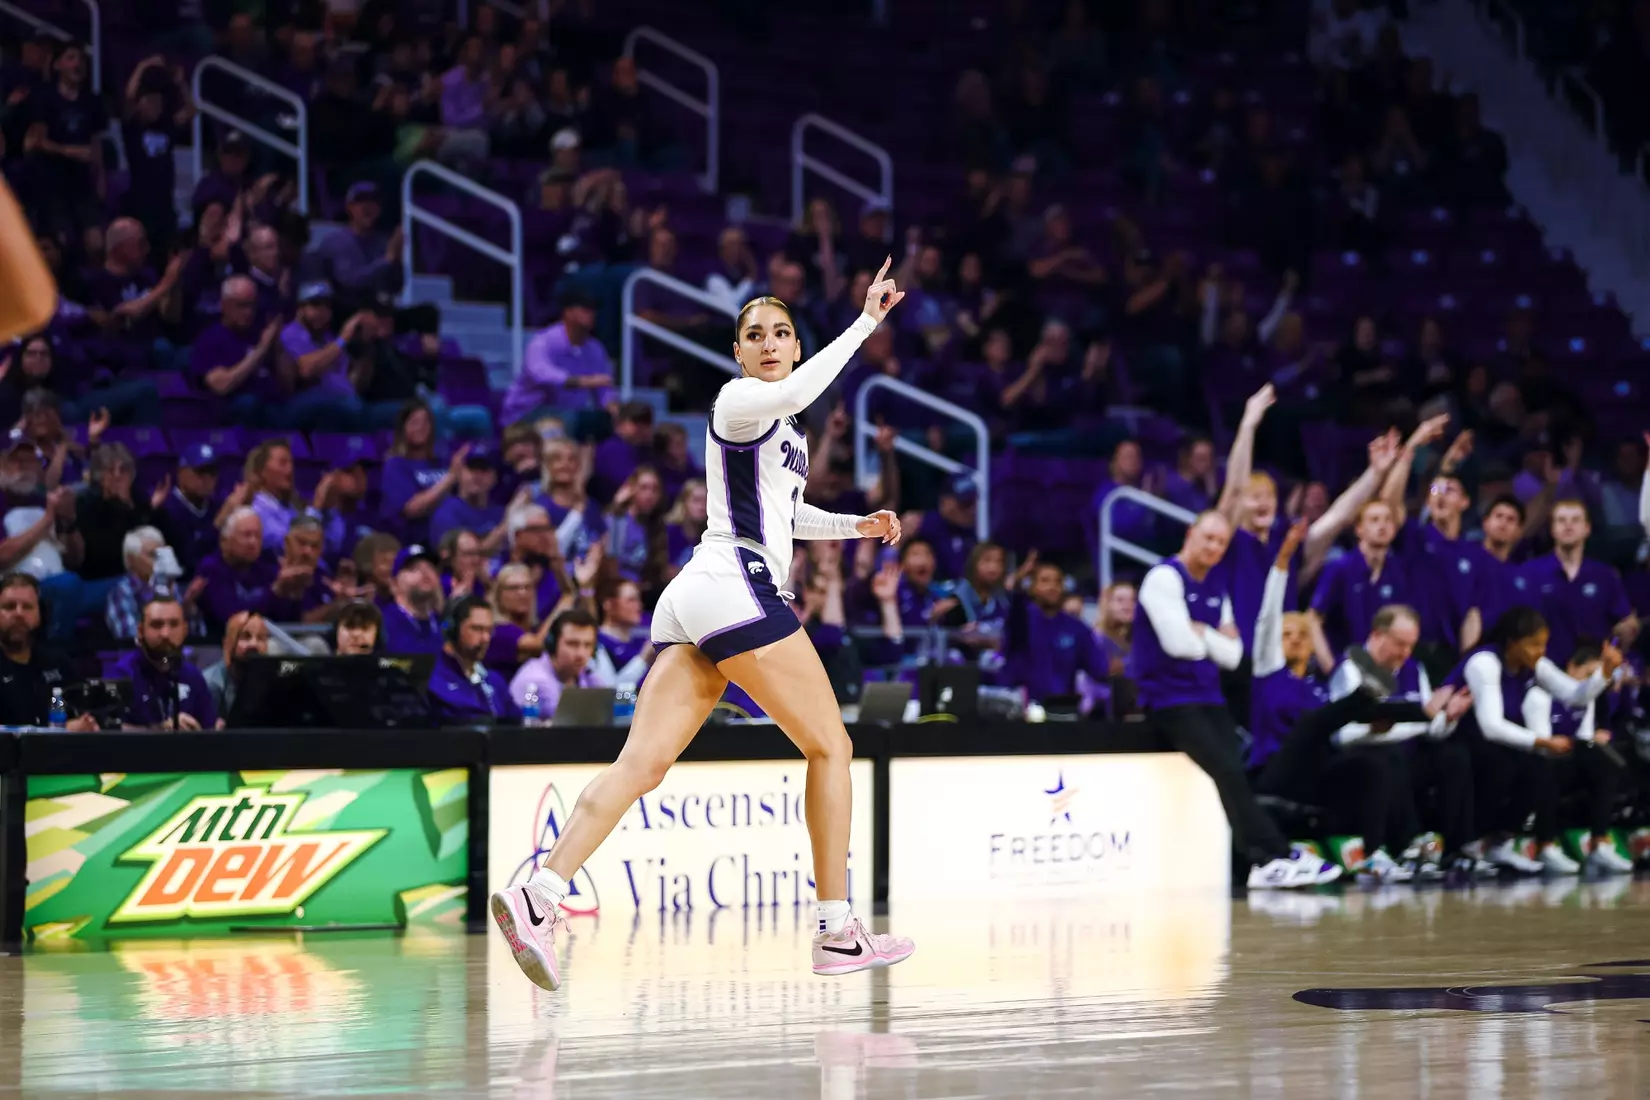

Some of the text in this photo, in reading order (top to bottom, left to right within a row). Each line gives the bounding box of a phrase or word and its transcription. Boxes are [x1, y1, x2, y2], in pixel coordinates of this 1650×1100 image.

[622, 775, 806, 830] Ascensi
[989, 829, 1132, 866] FREEDOM
[622, 852, 853, 911] Via Chrisi
